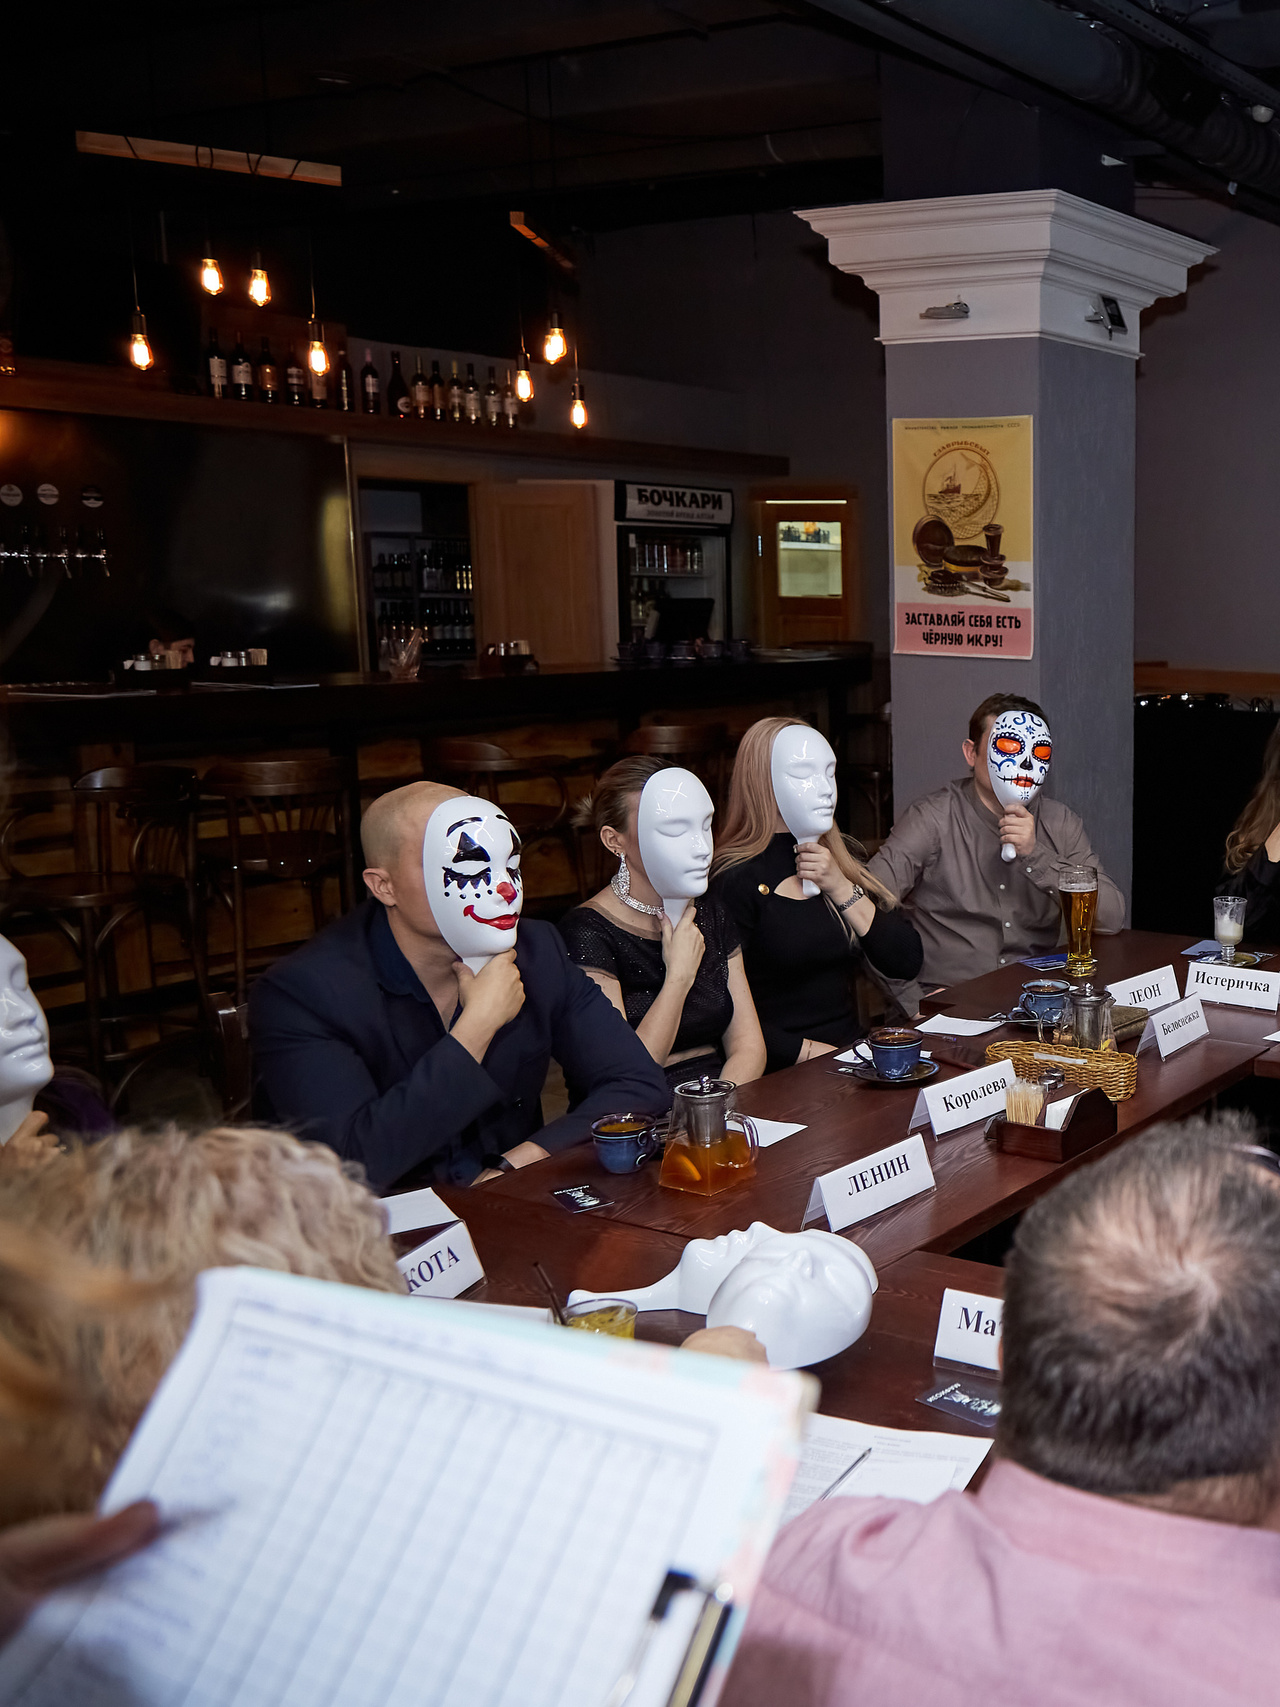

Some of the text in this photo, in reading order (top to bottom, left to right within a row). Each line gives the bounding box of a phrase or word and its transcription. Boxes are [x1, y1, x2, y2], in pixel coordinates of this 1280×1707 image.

[637, 488, 722, 510] БОЧКАРИ
[905, 611, 1021, 629] ЗАСТАВЛЯЙ СЕБЯ ЕСТЬ
[922, 629, 1003, 647] ЧЁРНУЮ ИКРУ!
[1194, 970, 1270, 993] Истеричка
[1128, 983, 1162, 1006] ЛЕОН
[1160, 1009, 1200, 1036] Белоснежка
[942, 1077, 1007, 1112] Королева
[848, 1153, 911, 1196] ЛЕНИН
[957, 1306, 1003, 1337] Ма
